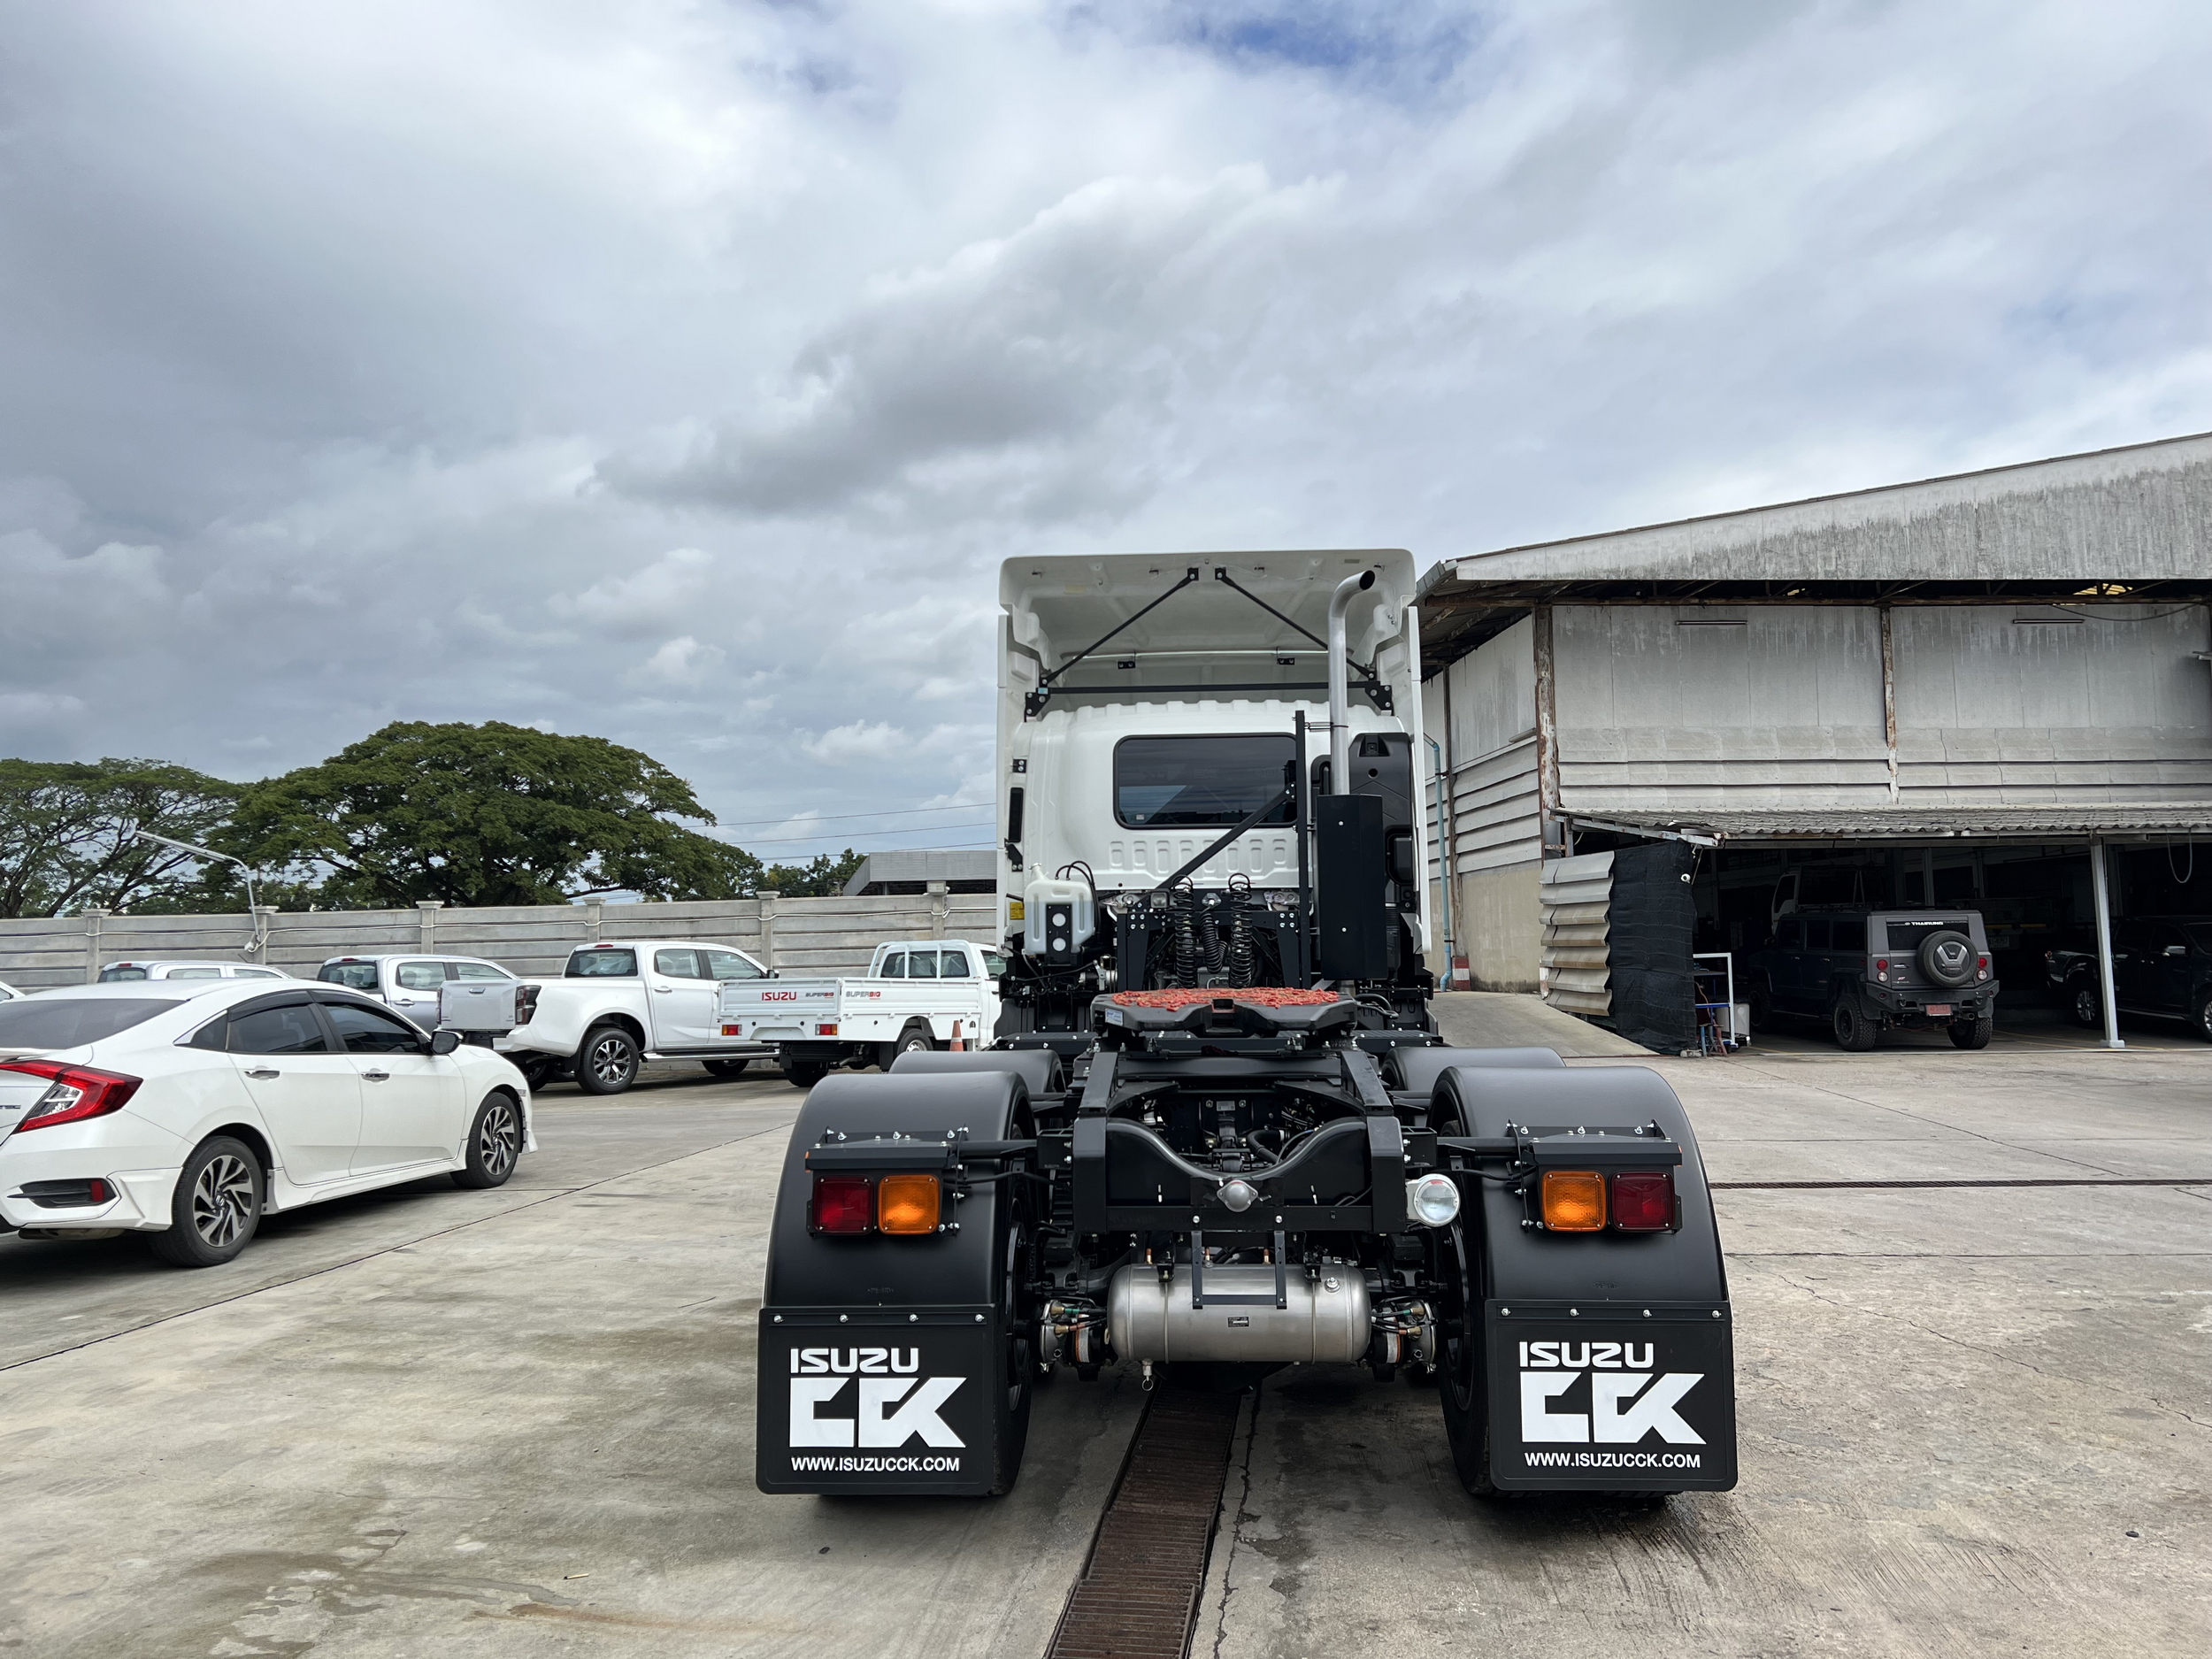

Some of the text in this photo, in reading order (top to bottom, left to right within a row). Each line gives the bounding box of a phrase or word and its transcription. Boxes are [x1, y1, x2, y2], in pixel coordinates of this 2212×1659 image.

[762, 992, 796, 1001] ISUZU
[790, 1348, 919, 1373] ISUZU
[1519, 1341, 1654, 1369] ISUZU
[789, 1377, 967, 1448] CCK
[1519, 1371, 1707, 1445] CCK
[791, 1456, 960, 1472] WWW.ISUZUCCK.COM
[1525, 1452, 1701, 1469] WWW.ISUZUCCK.COM
